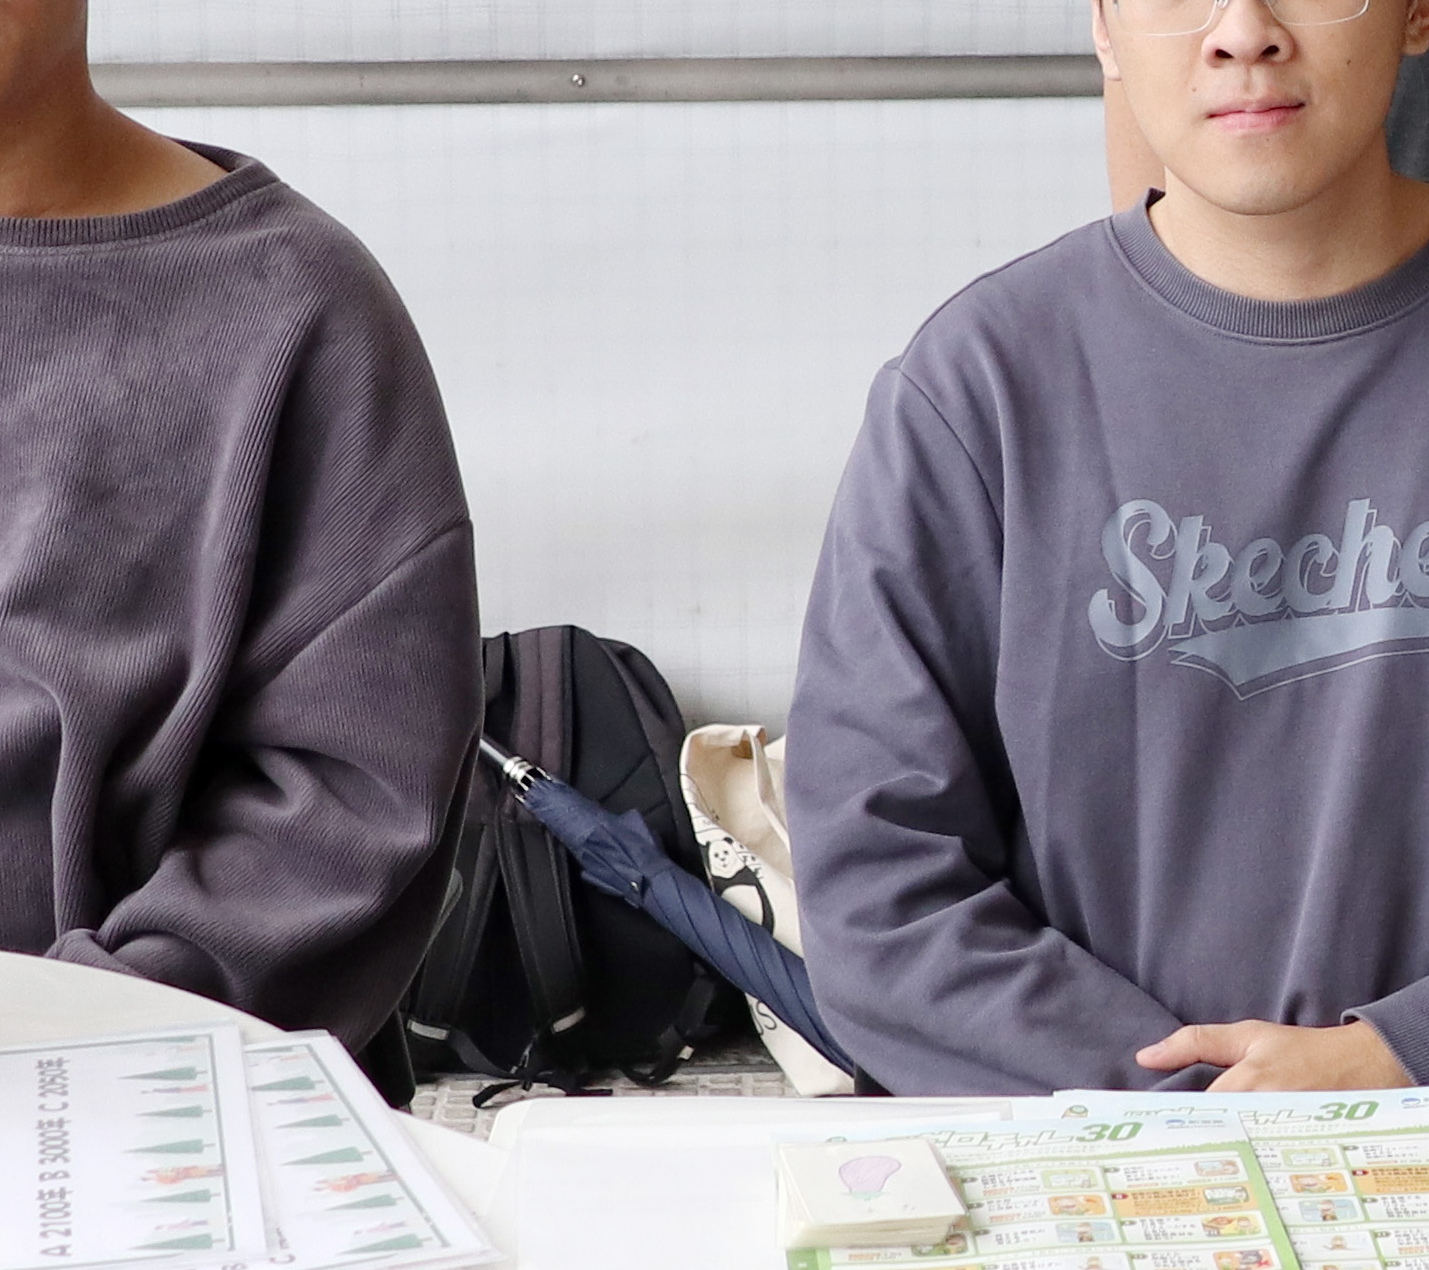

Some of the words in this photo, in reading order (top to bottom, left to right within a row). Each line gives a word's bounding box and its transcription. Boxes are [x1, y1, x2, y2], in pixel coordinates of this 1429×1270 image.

[37, 1101, 70, 1112] C
[35, 1117, 73, 1165] 3000年
[38, 1170, 72, 1182] B
[35, 1187, 74, 1239] 2100年
[40, 1244, 72, 1257] A
